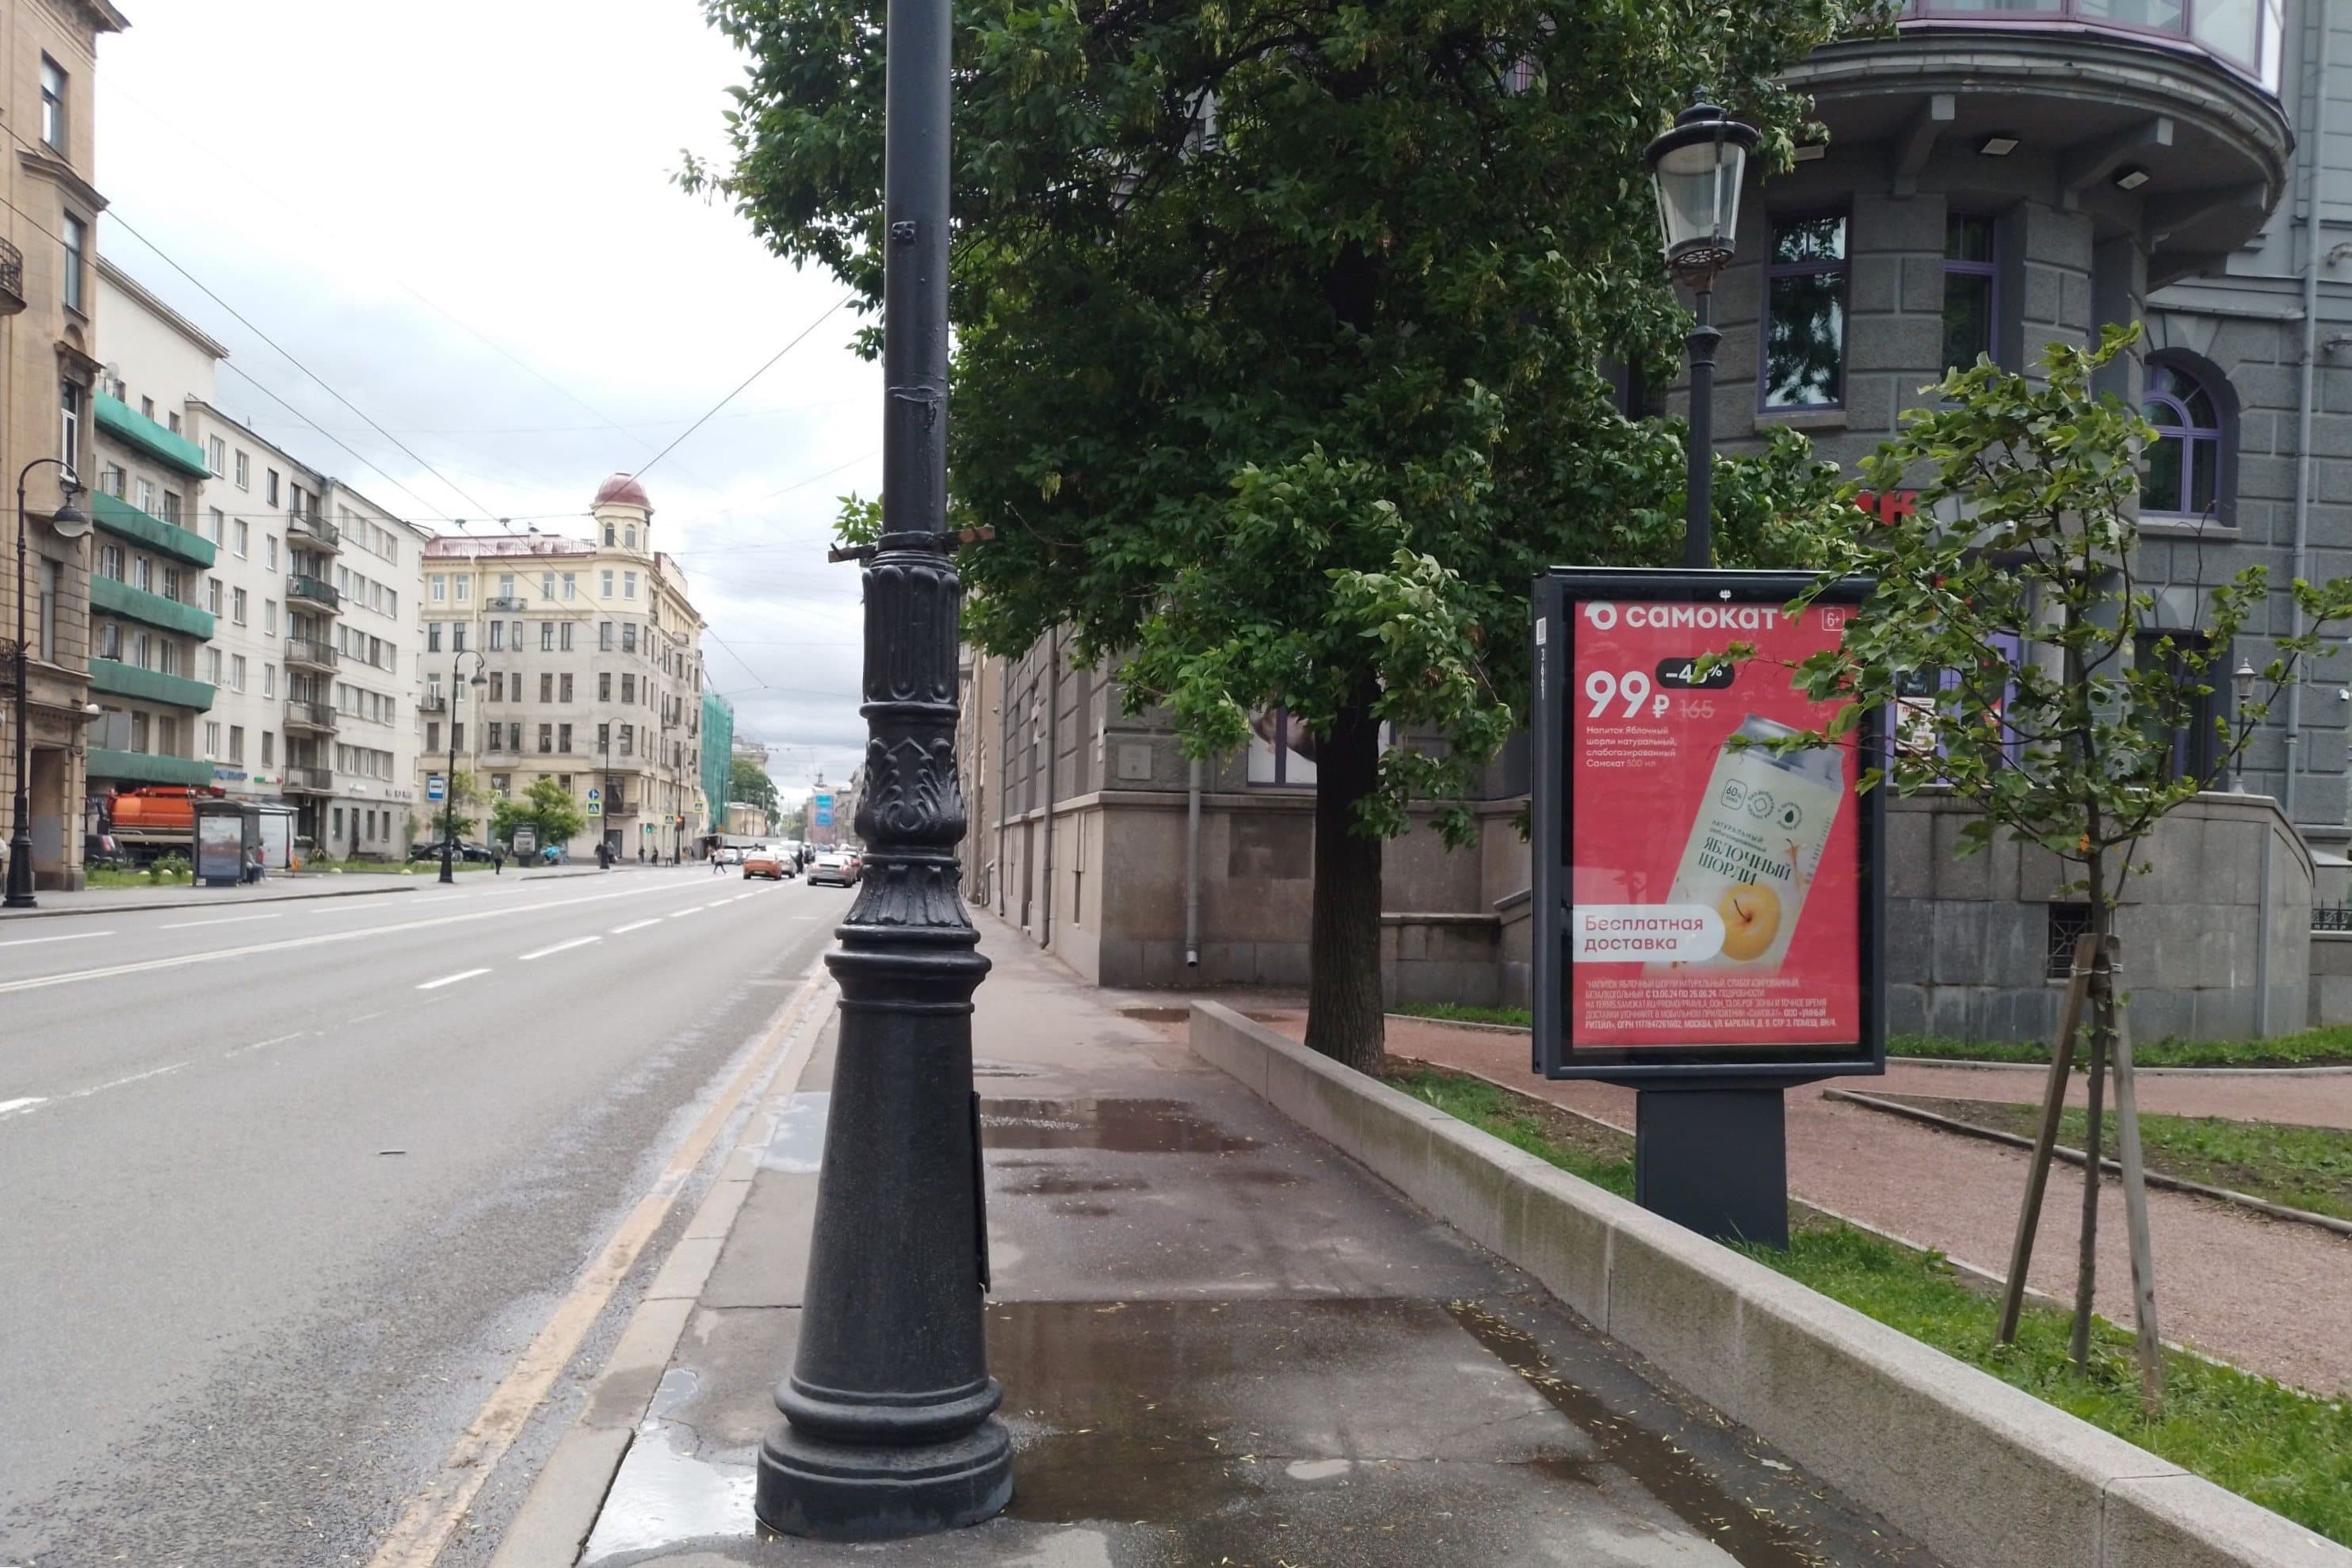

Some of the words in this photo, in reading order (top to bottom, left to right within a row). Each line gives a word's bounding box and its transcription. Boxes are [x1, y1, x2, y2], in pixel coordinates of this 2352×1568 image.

[1626, 605, 1777, 629] самокат
[1827, 614, 1841, 628] 6+
[1680, 700, 1715, 719] 165
[1586, 726, 1624, 734] Напиток
[1625, 726, 1668, 734] Яблочный
[1586, 738, 1616, 748] шорли
[1617, 738, 1677, 748] натуральный,
[1586, 748, 1676, 757] слабогазированный
[1586, 759, 1625, 768] Самокат
[1712, 819, 1763, 844] НАТУРАЛЬНЫЙ
[1704, 836, 1792, 881] ЯБЛОЧНЫЙ
[1698, 853, 1757, 887] ШОРЛИ
[1585, 914, 1704, 931] Бесплатная
[1584, 937, 1677, 953] доставка
